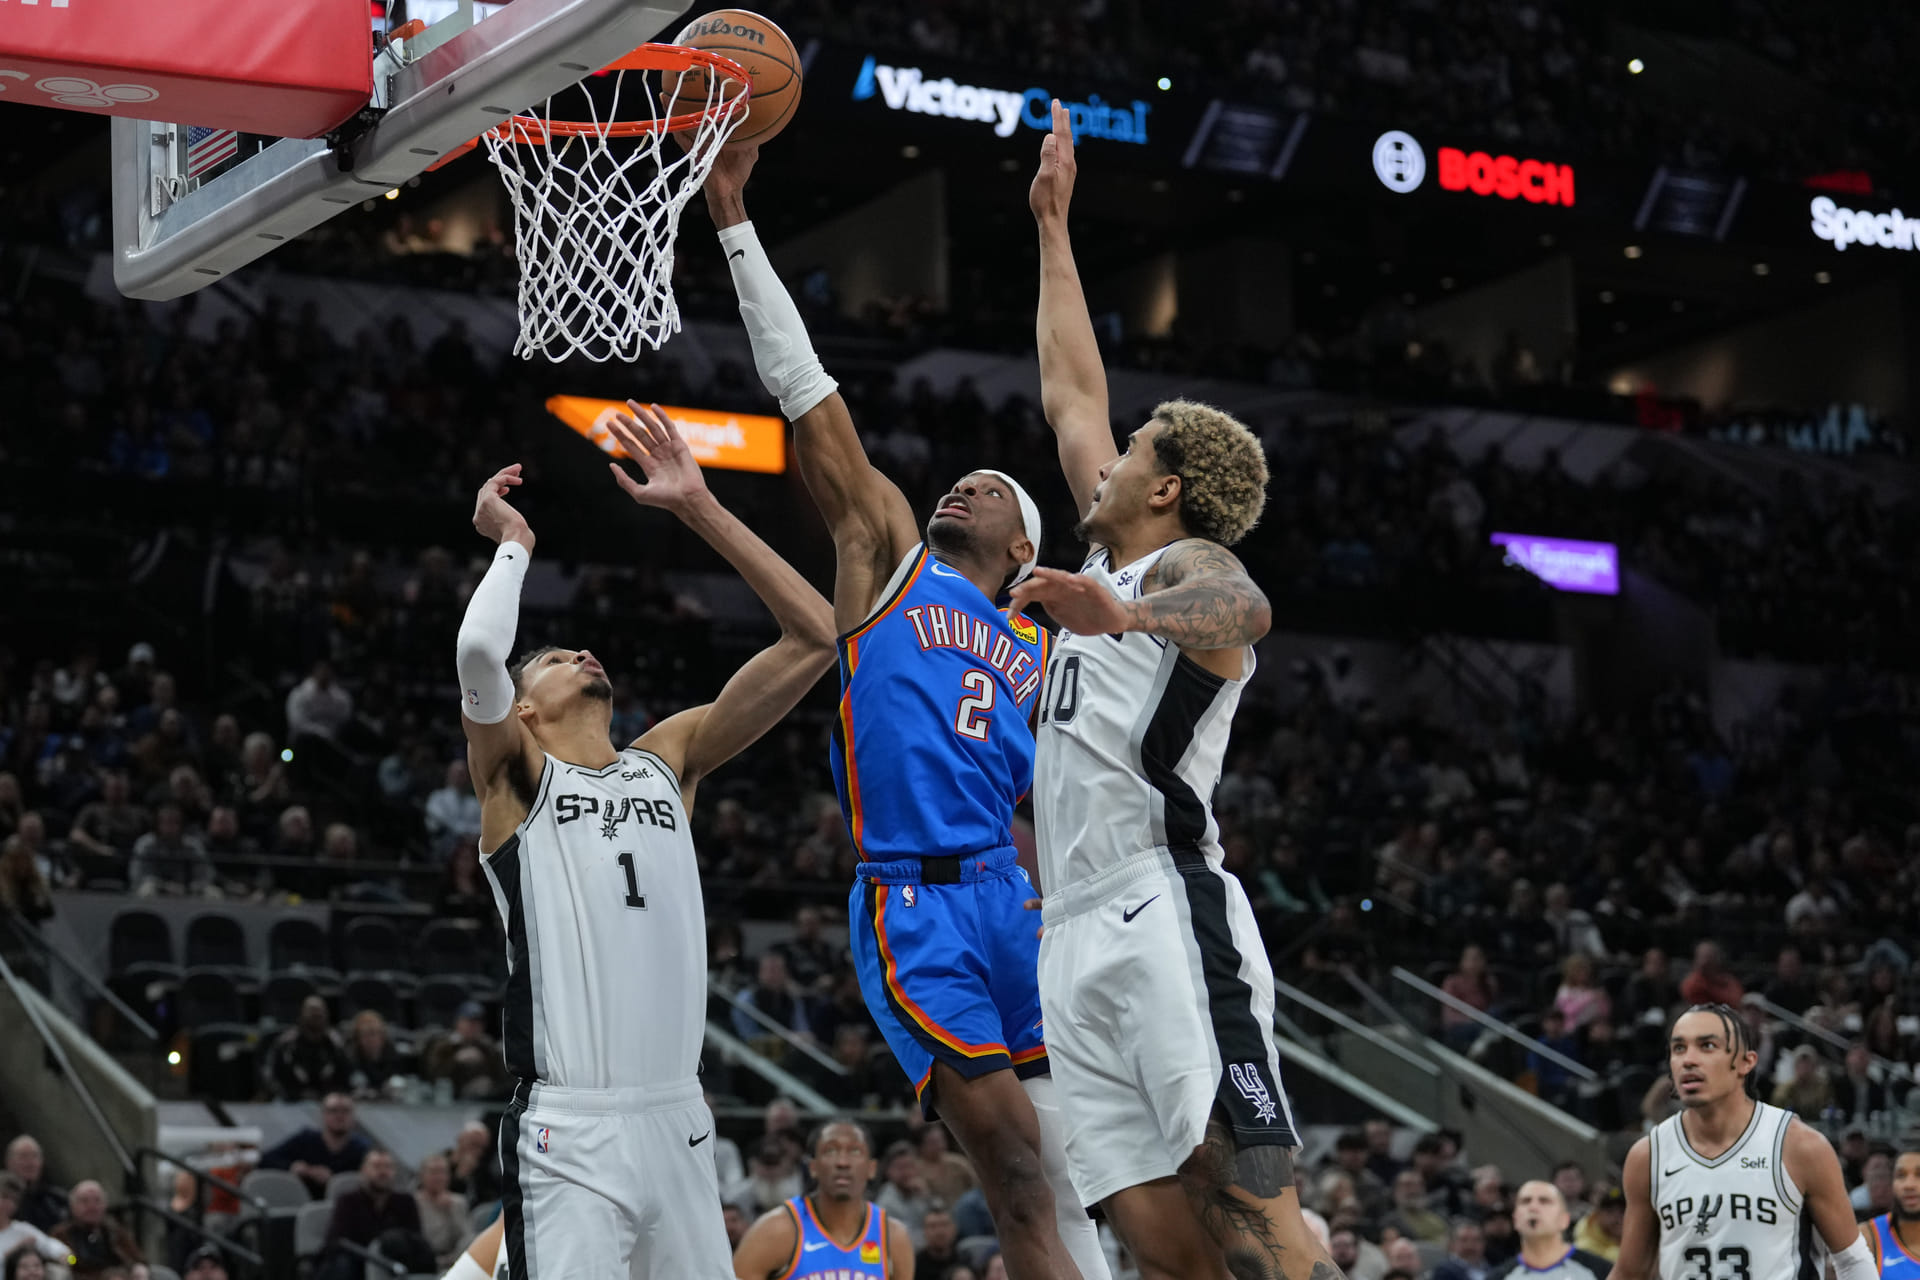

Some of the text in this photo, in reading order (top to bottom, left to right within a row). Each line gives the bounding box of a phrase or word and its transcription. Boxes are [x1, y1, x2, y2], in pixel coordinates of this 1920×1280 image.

[1437, 147, 1575, 207] BOSCH
[903, 604, 1042, 709] THUNDER
[954, 668, 996, 743] 2
[1039, 655, 1082, 727] 10
[621, 768, 654, 782] Self.
[556, 793, 676, 841] SPURS
[615, 850, 648, 911] 1
[1740, 1156, 1769, 1169] Self.
[1660, 1193, 1777, 1236] SPURS
[1684, 1247, 1751, 1280] 33
